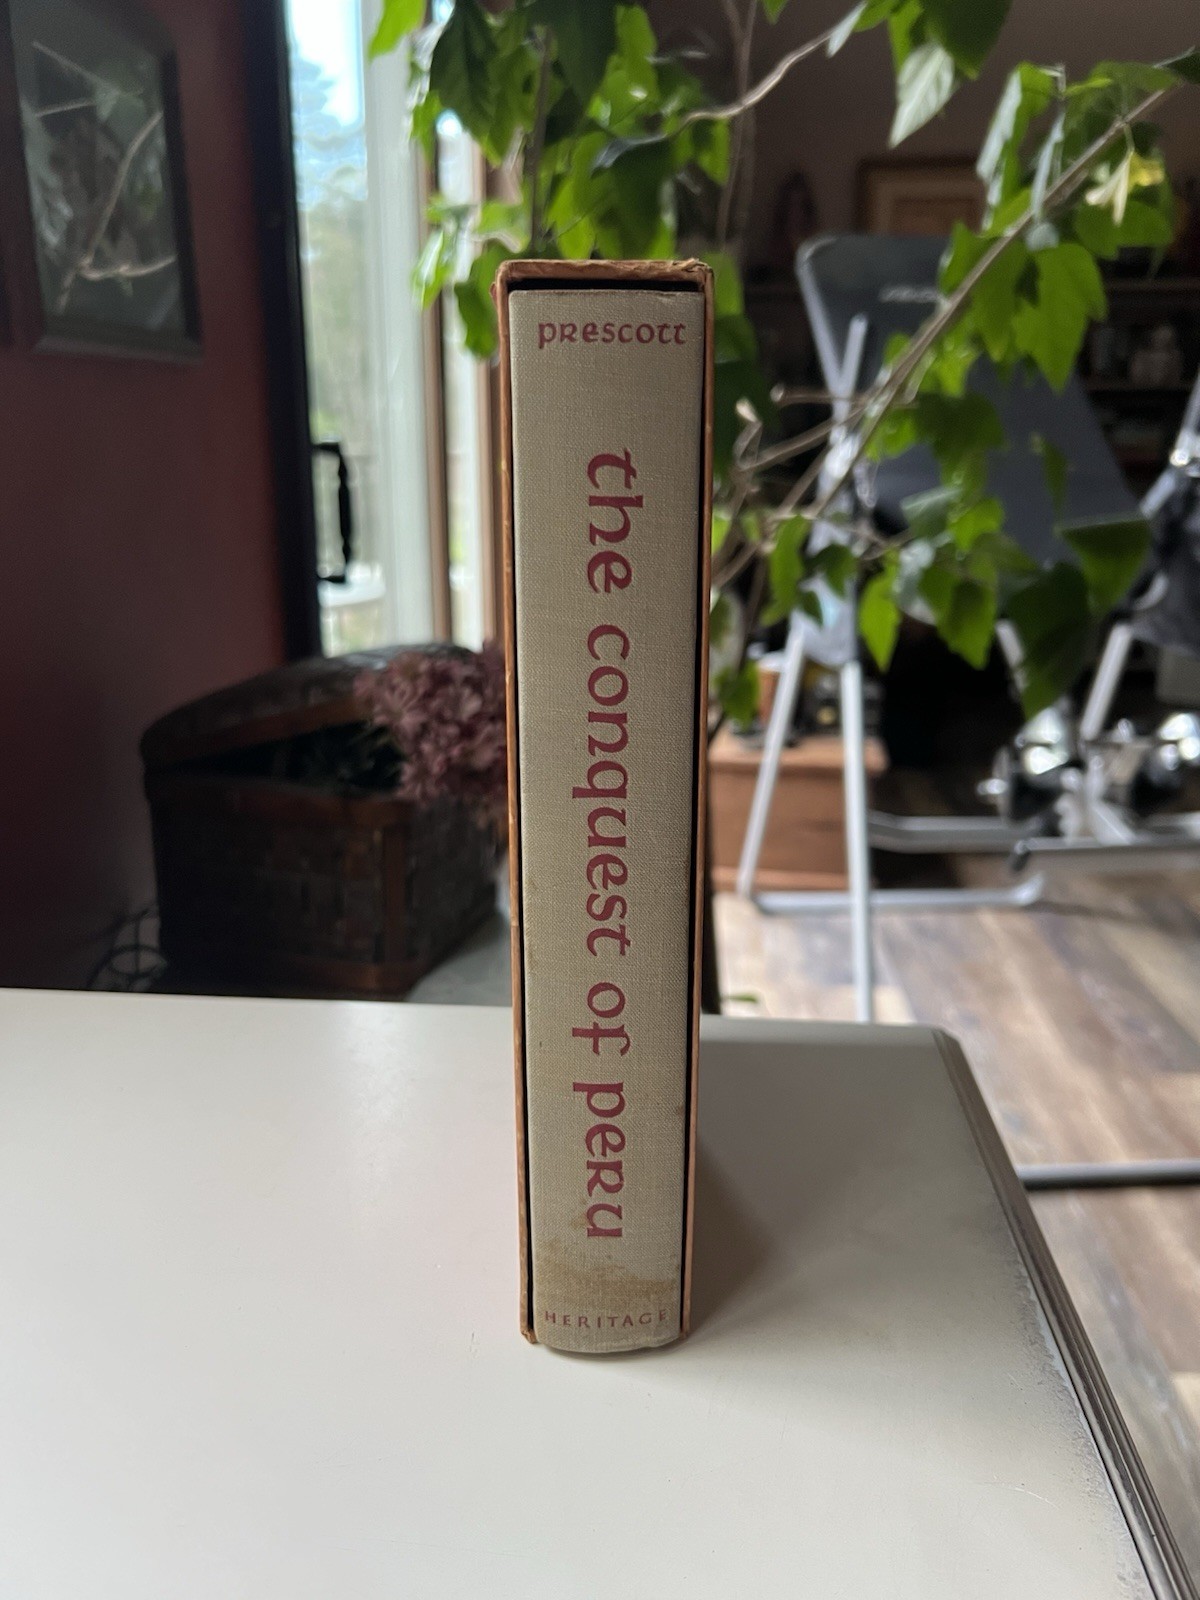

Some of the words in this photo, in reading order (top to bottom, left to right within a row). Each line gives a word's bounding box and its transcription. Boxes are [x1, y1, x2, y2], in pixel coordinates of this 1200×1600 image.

[586, 447, 644, 593] the
[571, 623, 631, 956] conquest
[571, 981, 631, 1056] of
[544, 1309, 668, 1328] HERITAGE
